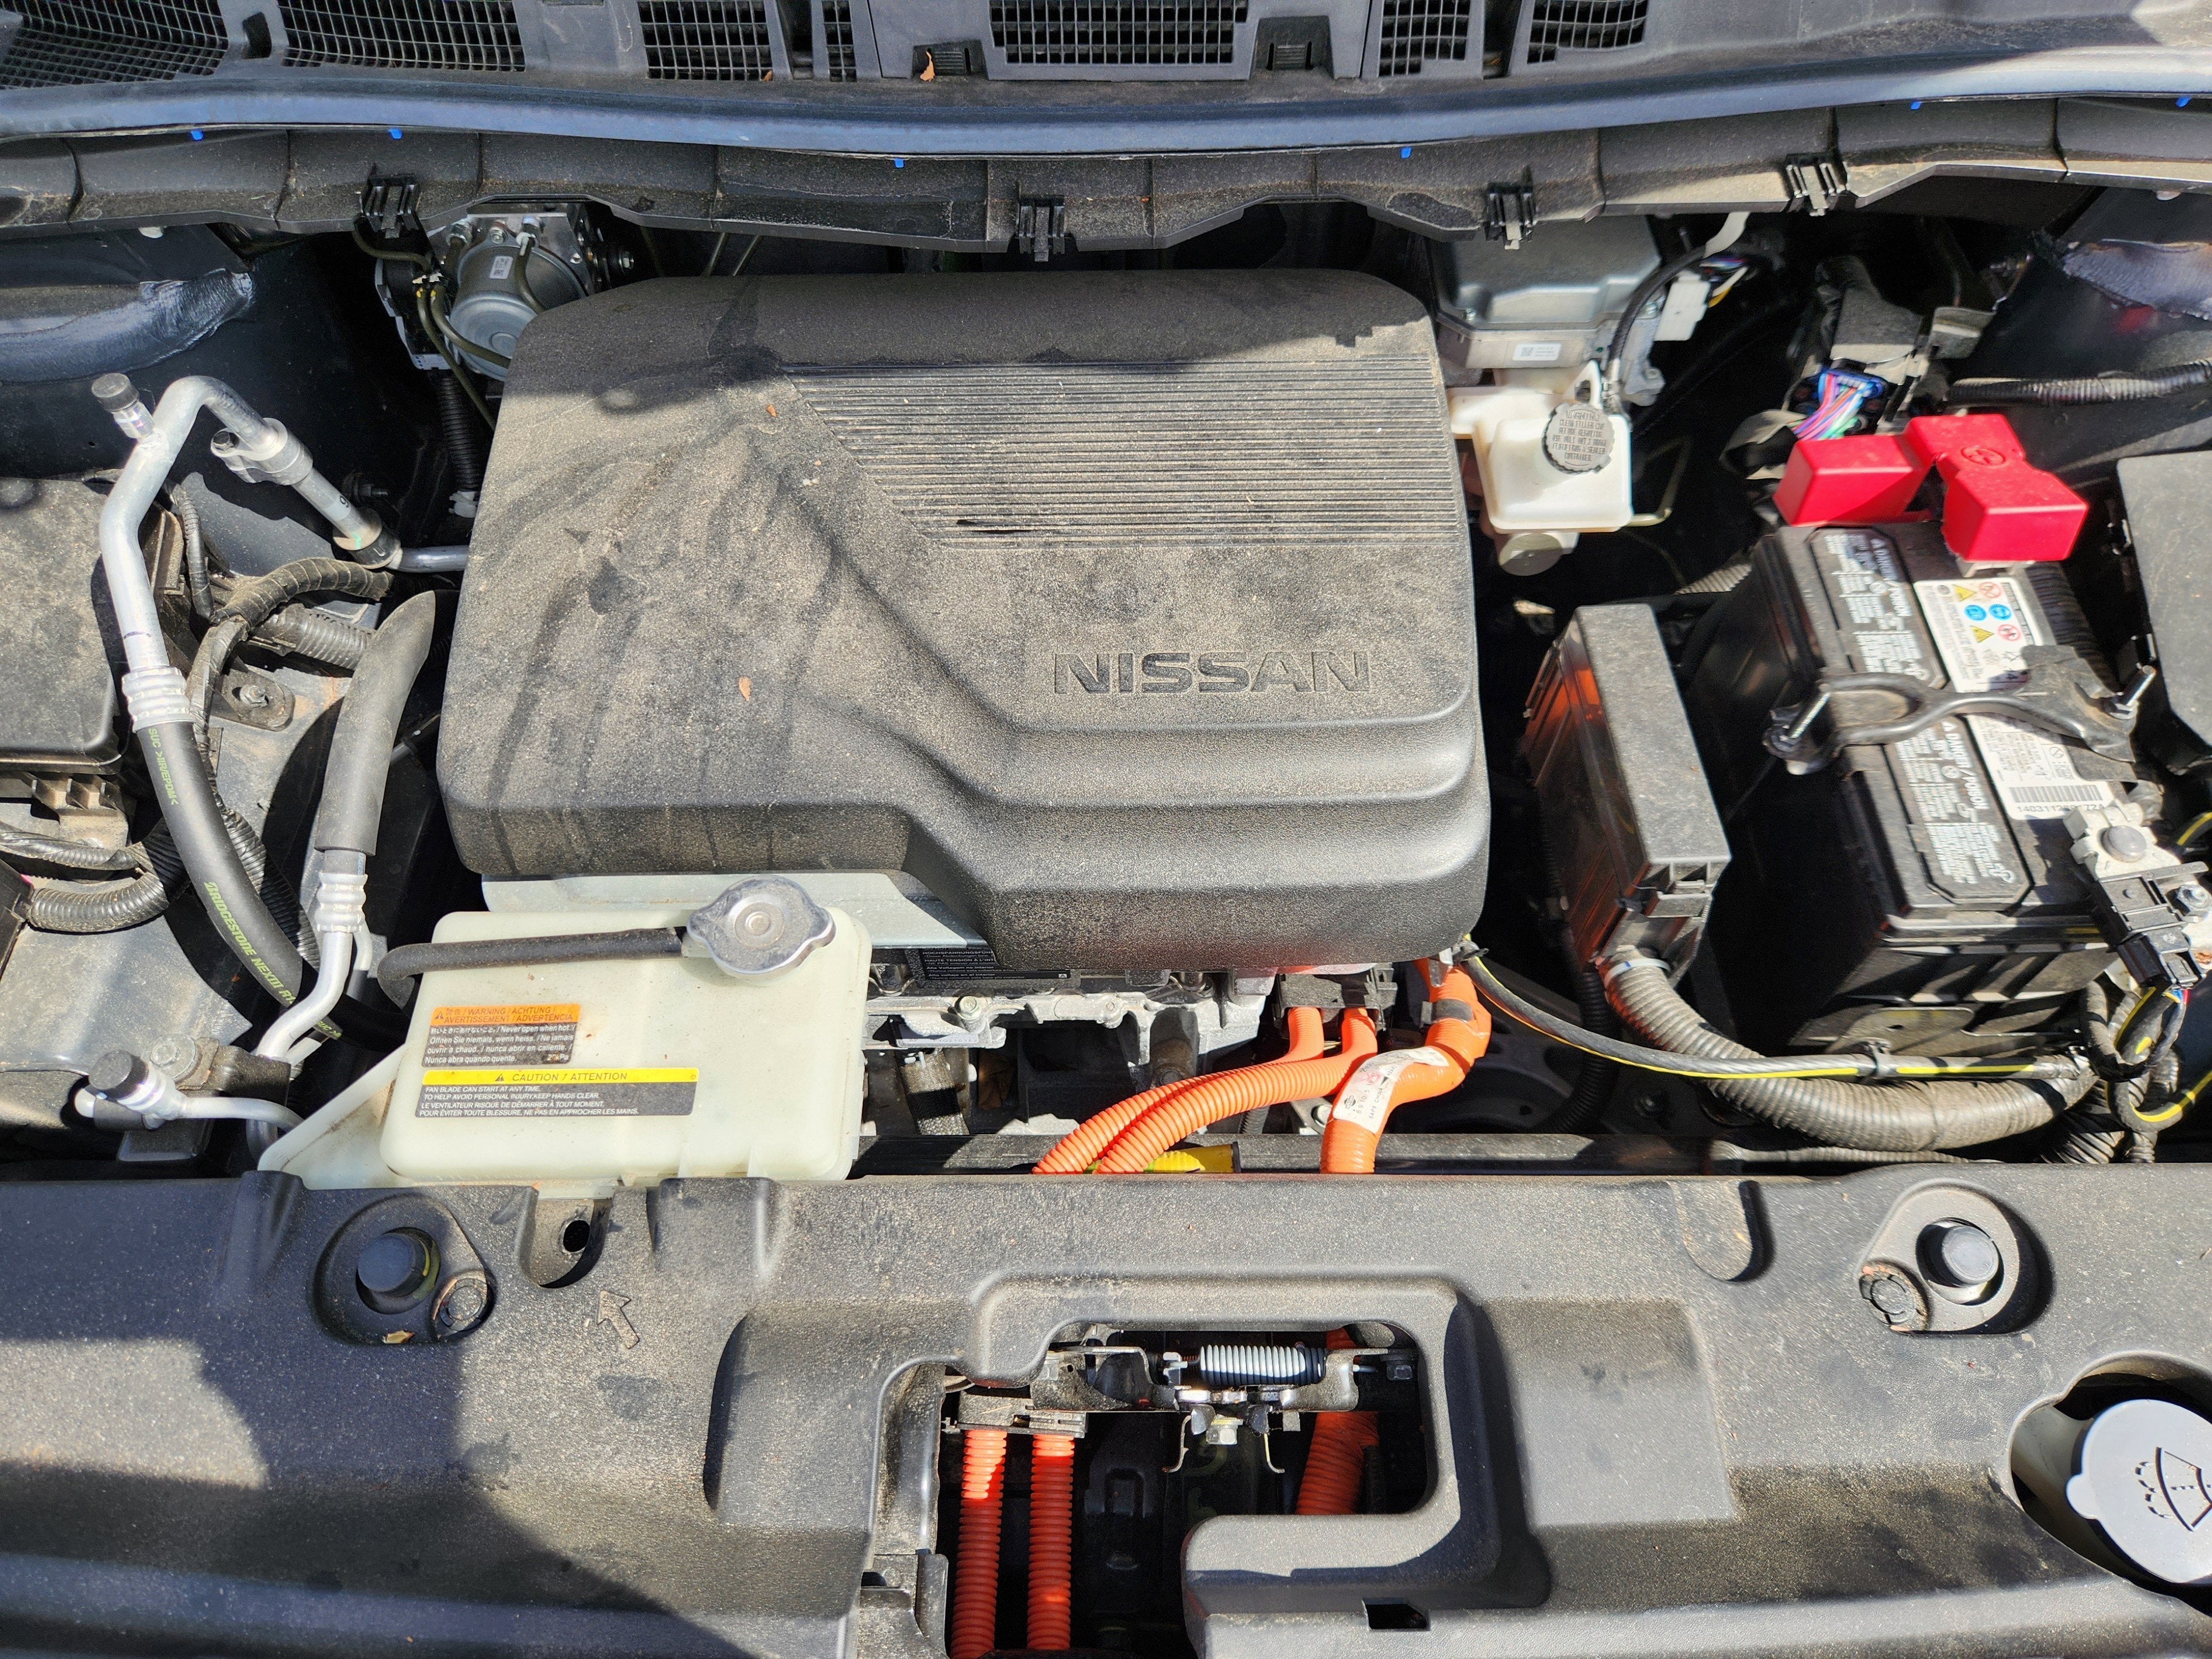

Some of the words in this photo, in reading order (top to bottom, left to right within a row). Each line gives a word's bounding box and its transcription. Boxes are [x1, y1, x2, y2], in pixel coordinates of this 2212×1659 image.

[1053, 651, 1371, 694] NISSAN
[148, 728, 162, 748] SUC
[204, 881, 257, 956] BRIDGESTONE
[278, 989, 297, 1005] R1
[468, 1007, 507, 1015] WARNING
[512, 1006, 552, 1015] ACHTUNG
[444, 1015, 509, 1024] AVERTISSEMENT
[521, 1026, 540, 1035] open
[495, 1035, 514, 1044] wenn
[551, 1034, 574, 1042] jamais
[465, 1055, 490, 1064] quando
[491, 1055, 518, 1064] quente.
[512, 1073, 559, 1081] CAUTION
[570, 1072, 628, 1081] ATTENTION
[1374, 1087, 1383, 1103] CHINA
